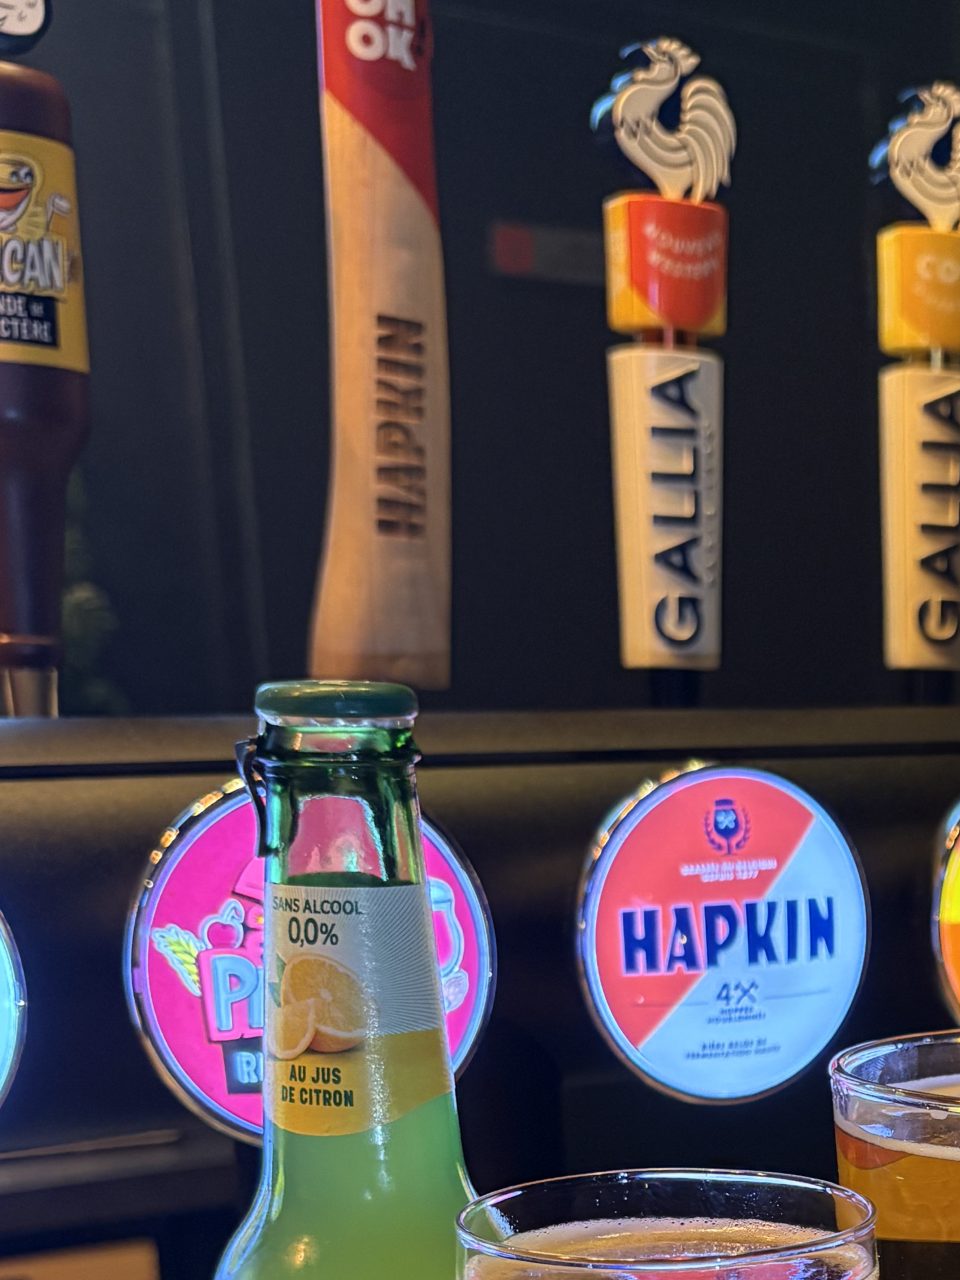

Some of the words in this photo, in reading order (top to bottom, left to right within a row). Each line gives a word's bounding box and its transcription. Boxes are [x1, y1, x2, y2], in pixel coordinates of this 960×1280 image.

[376, 315, 426, 538] HAPKIN
[650, 363, 703, 649] GALLIA
[272, 896, 300, 913] SANS
[303, 899, 363, 915] ALCOOL
[288, 917, 338, 947] 0,0%
[619, 897, 835, 976] HAPKIN
[289, 1064, 307, 1083] AU
[312, 1066, 342, 1085] JUS
[281, 1085, 295, 1104] DE
[299, 1086, 354, 1107] CITRON
